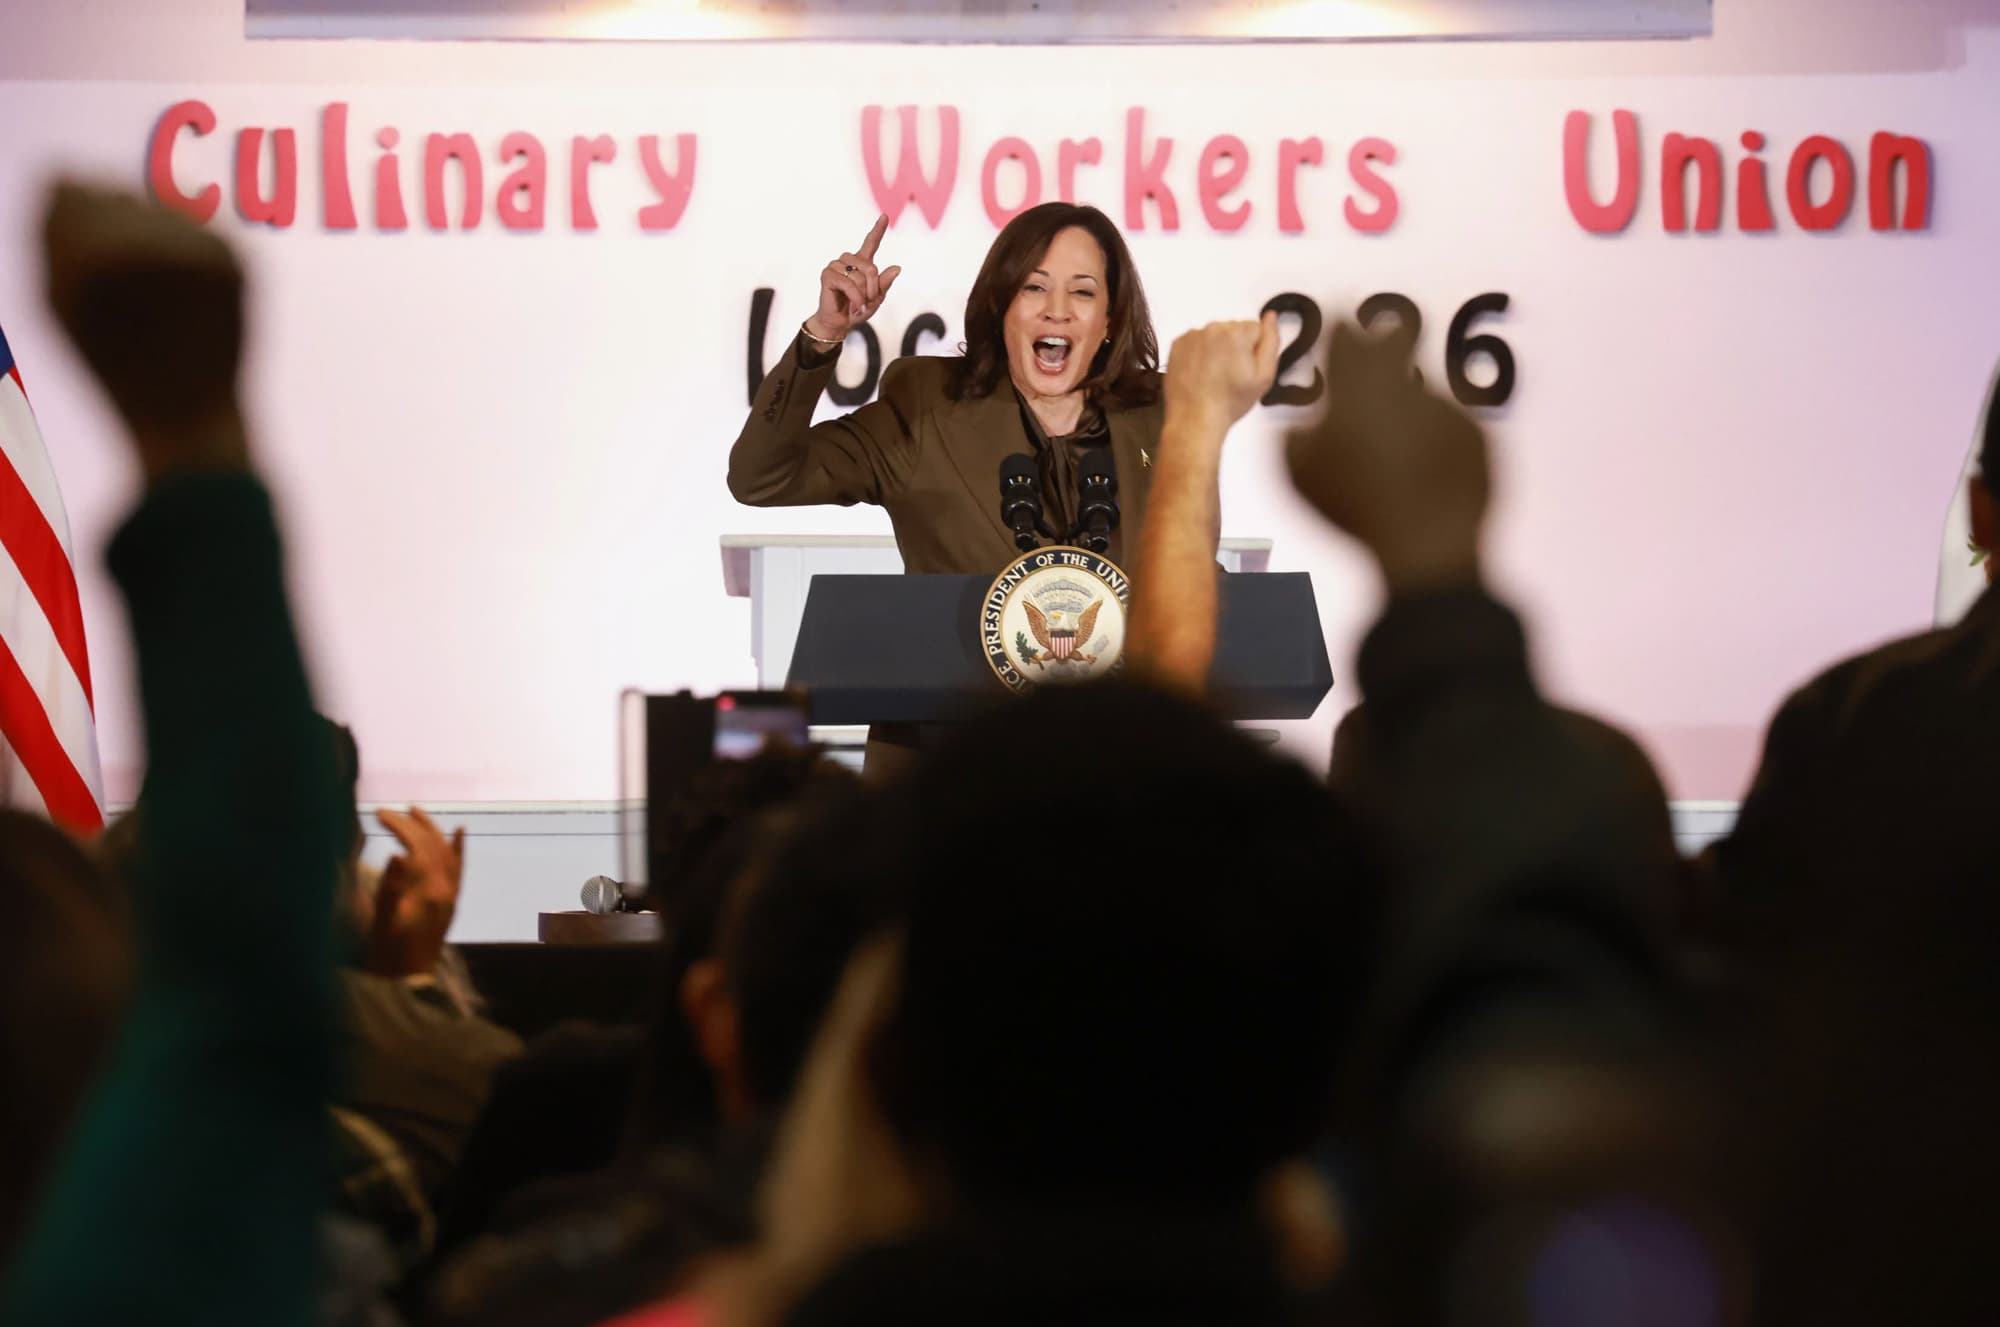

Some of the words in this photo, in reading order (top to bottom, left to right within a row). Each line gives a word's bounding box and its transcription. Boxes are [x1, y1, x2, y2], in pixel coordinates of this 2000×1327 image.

[149, 100, 698, 230] Culinary
[861, 104, 1400, 233] Workers
[1563, 109, 1932, 233] Union
[748, 288, 946, 406] Loc
[1035, 553, 1055, 568] OF
[1061, 553, 1089, 568] THE
[1096, 562, 1128, 600] UNI
[986, 561, 1028, 656] PRESIDENT
[998, 660, 1026, 690] ICE
